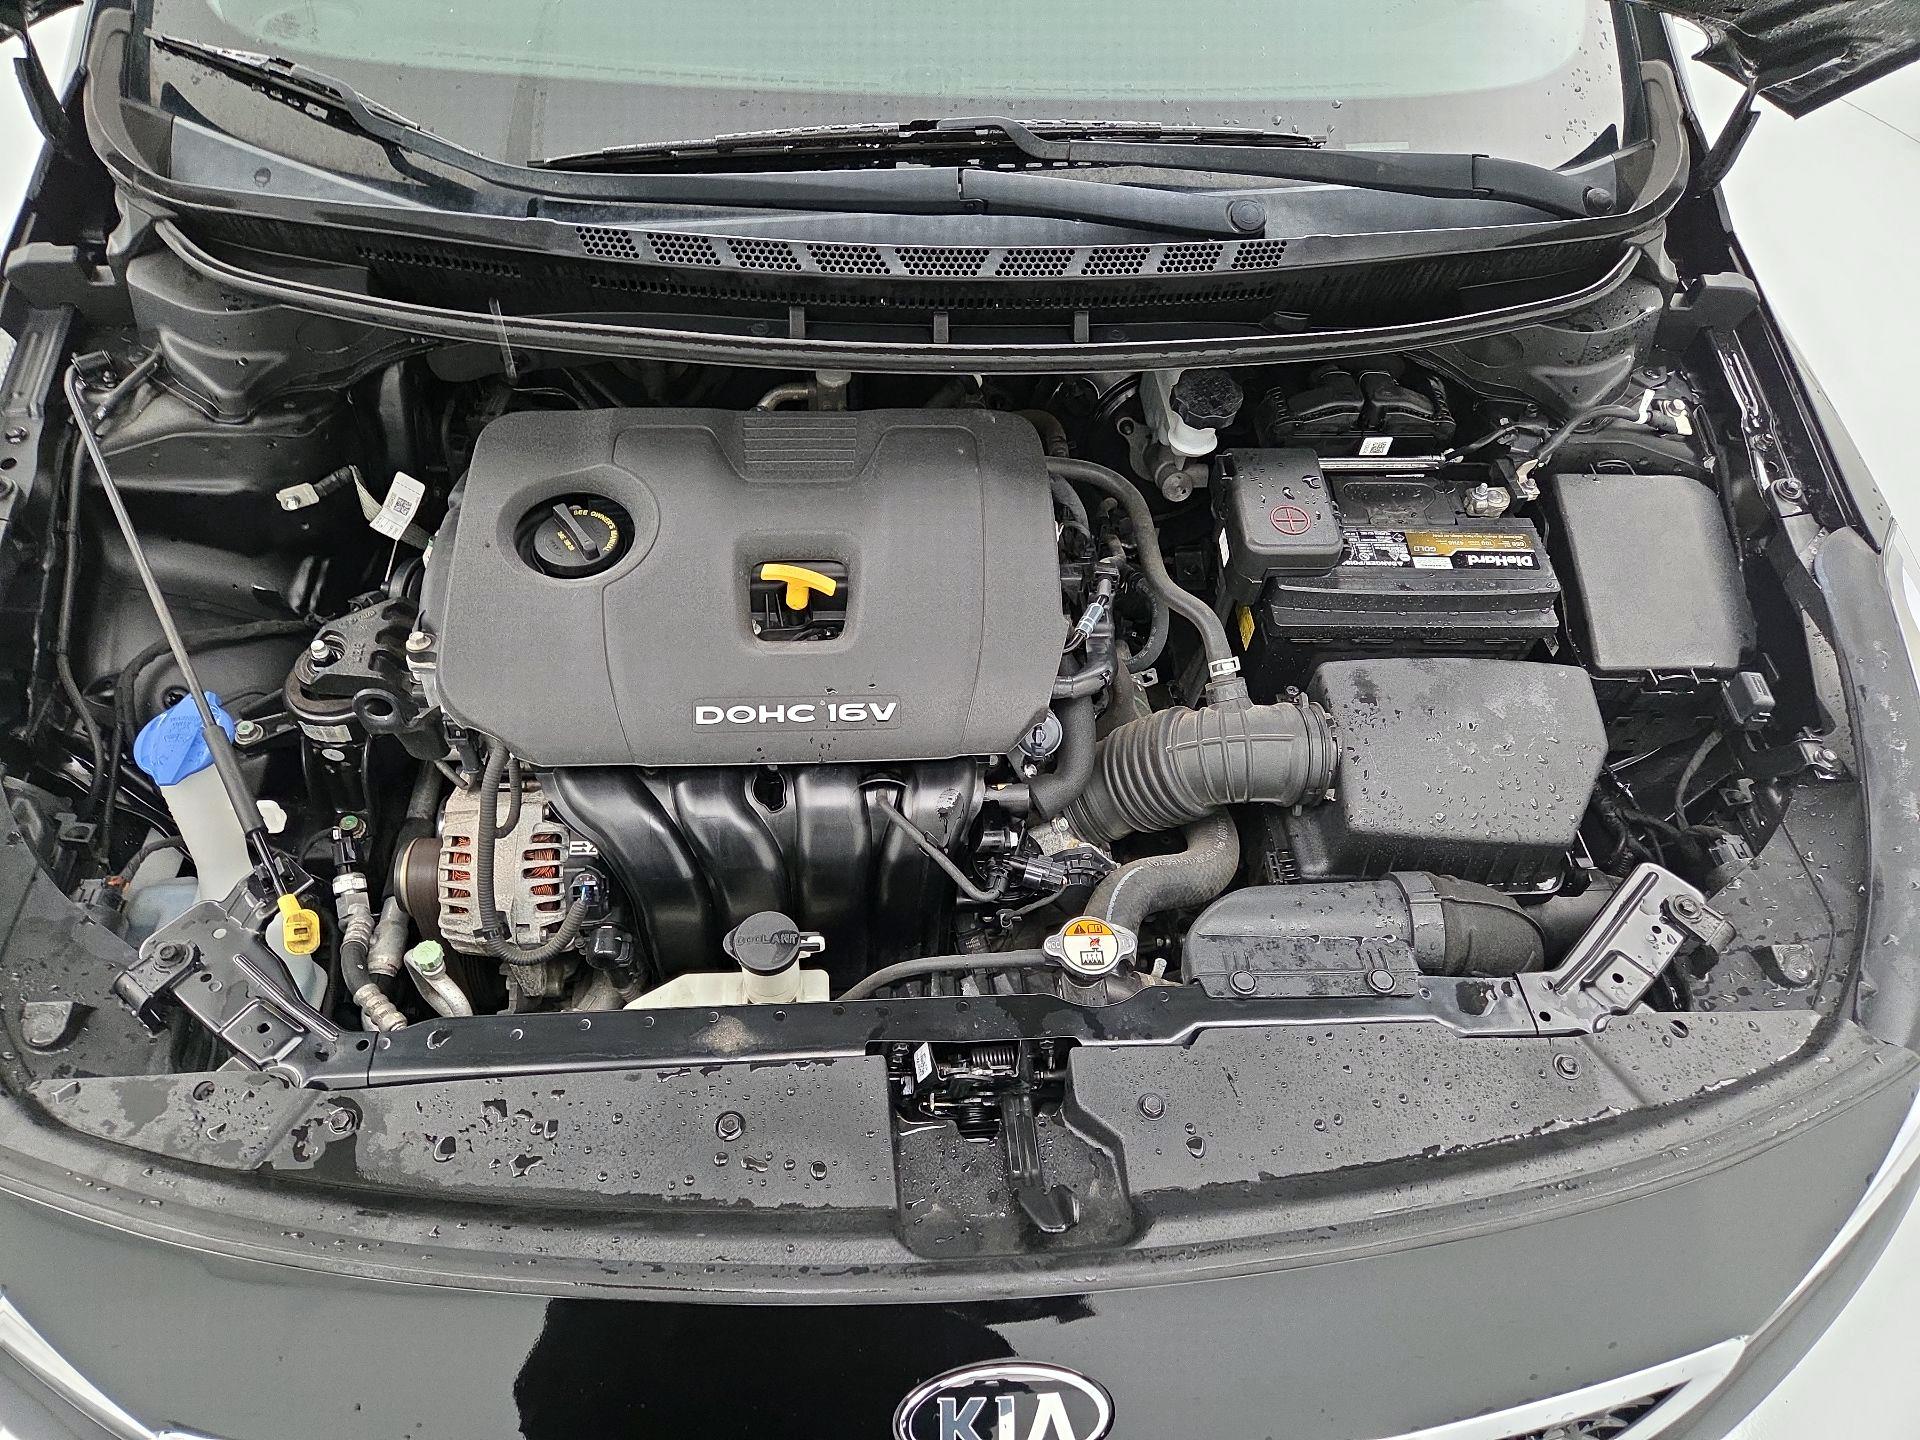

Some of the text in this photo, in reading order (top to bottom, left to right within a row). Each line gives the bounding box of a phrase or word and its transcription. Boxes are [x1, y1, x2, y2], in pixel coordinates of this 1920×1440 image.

[590, 511, 616, 530] OWNER'S
[602, 528, 619, 552] MANUAL
[1467, 554, 1534, 567] DieHard
[695, 702, 897, 725] DOHC 16V
[936, 1392, 1077, 1440] KIA
